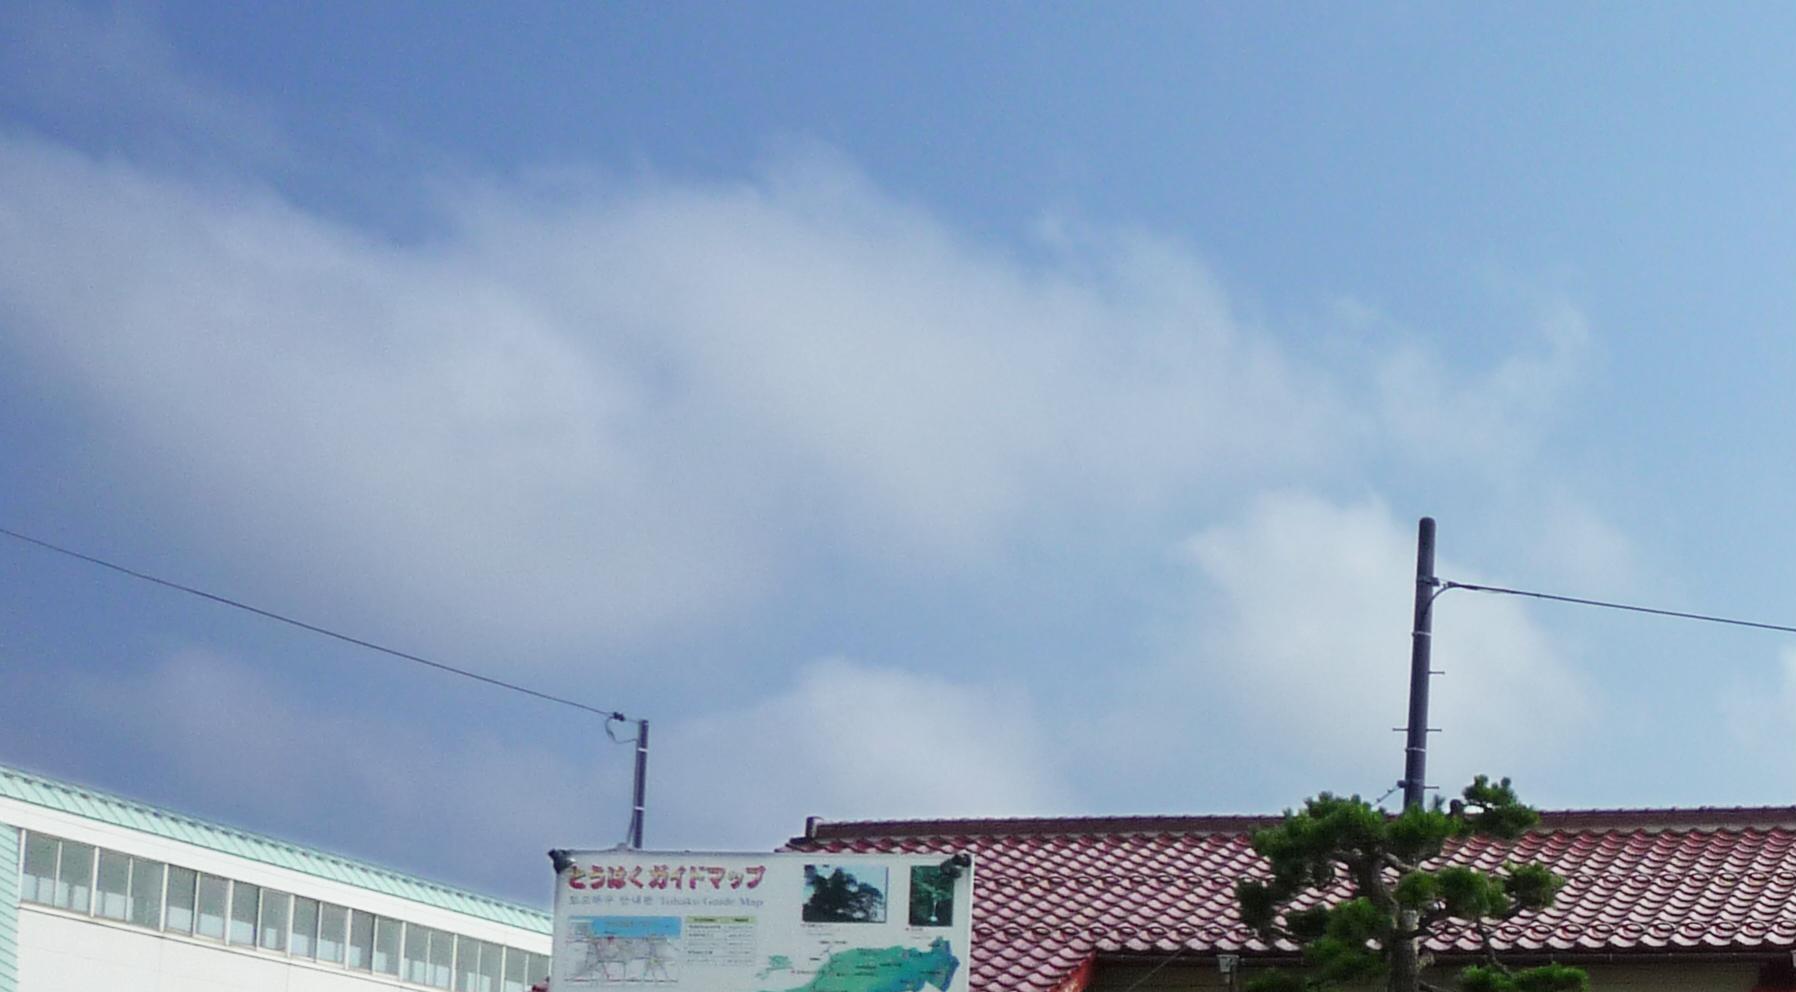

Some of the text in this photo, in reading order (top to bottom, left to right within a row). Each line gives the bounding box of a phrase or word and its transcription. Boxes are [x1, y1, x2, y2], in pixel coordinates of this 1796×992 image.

[568, 864, 767, 890] とうはくガイドマップ
[702, 896, 736, 906] Guide
[738, 896, 764, 909] Map
